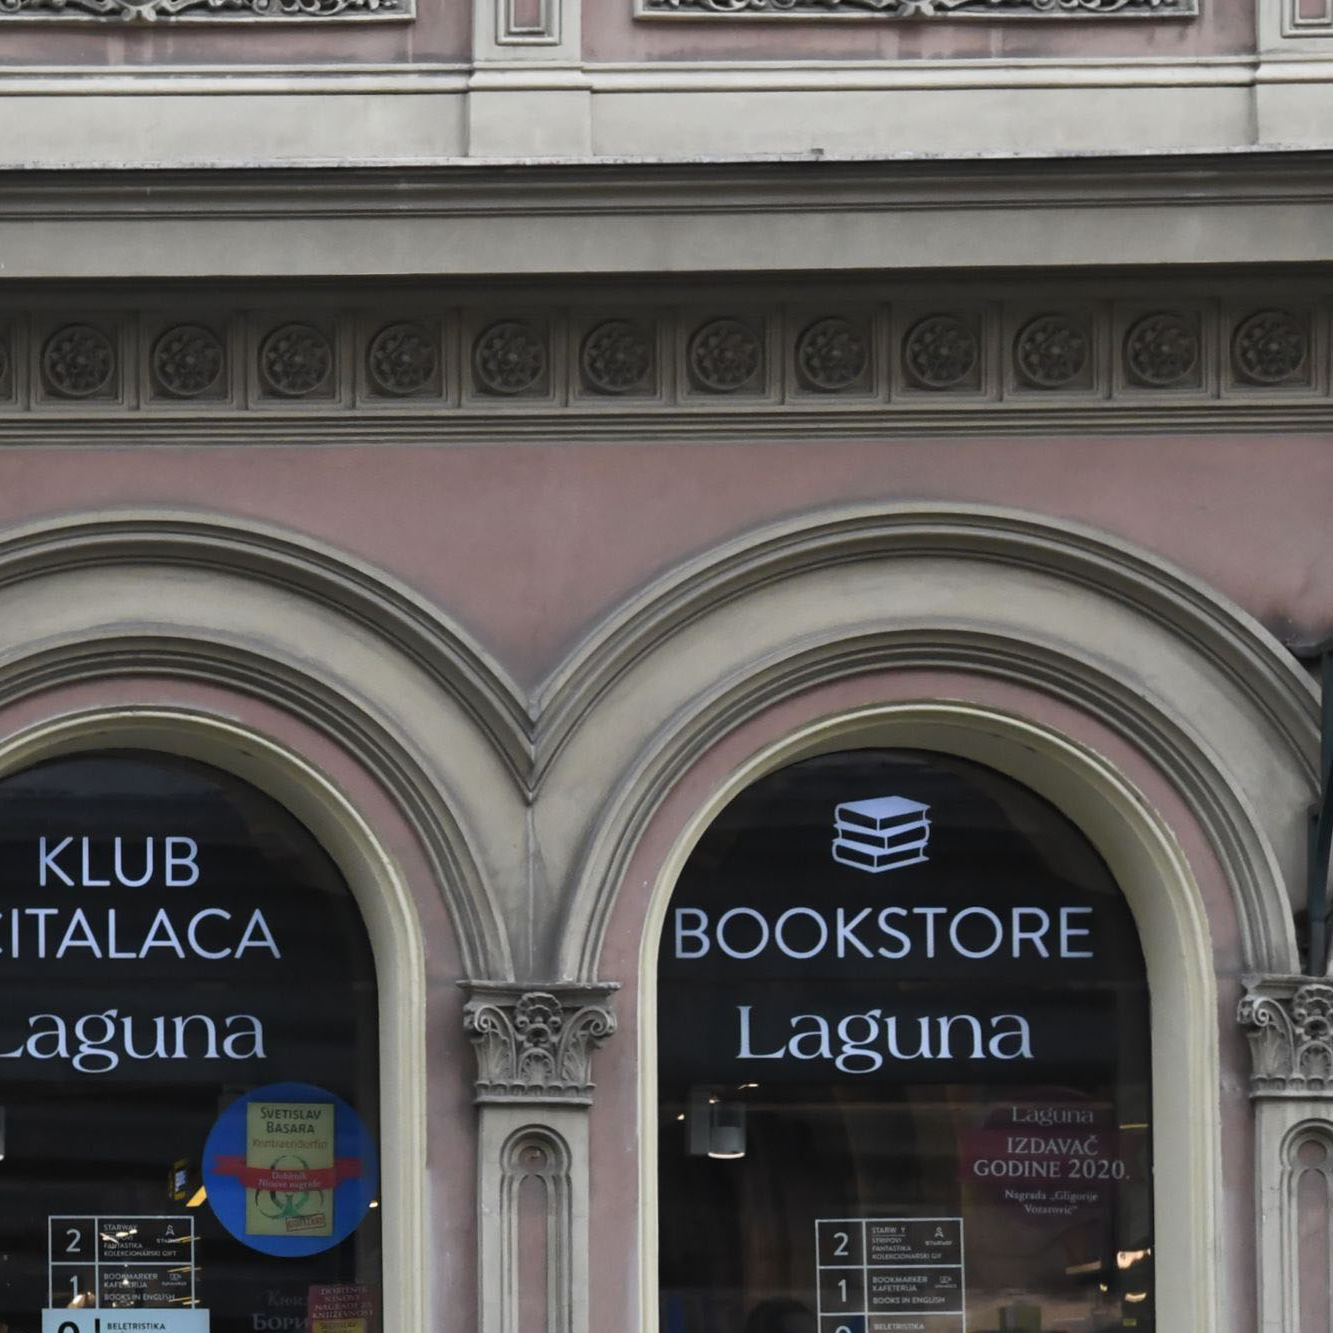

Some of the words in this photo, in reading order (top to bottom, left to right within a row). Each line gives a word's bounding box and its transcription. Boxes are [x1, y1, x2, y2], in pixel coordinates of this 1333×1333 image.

[40, 837, 200, 886] KLUB
[675, 907, 1093, 959] BOOKSTORE
[736, 1006, 1034, 1074] Laguna
[260, 1107, 322, 1120] SVETISLAV
[1012, 1106, 1094, 1125] Laguna
[266, 1121, 315, 1134] BASARA
[1007, 1134, 1098, 1155] IZDAVAČ
[973, 1160, 1061, 1177] GODINE
[1068, 1160, 1130, 1180] 2020.
[1004, 1189, 1046, 1201] Nagrada
[66, 1229, 82, 1253] 2
[833, 1232, 849, 1257] 2
[161, 1249, 176, 1257] GIFT
[872, 1276, 928, 1284] BOOKMARKER
[837, 1279, 847, 1303] 1
[872, 1285, 917, 1293] KAFETERIJA
[873, 1296, 900, 1305] BOOKS
[902, 1296, 911, 1304] IN
[912, 1296, 946, 1304] ENGLISH
[107, 1322, 166, 1330] BELETRISTIKA
[874, 1322, 925, 1330] BELETRISTIKA
